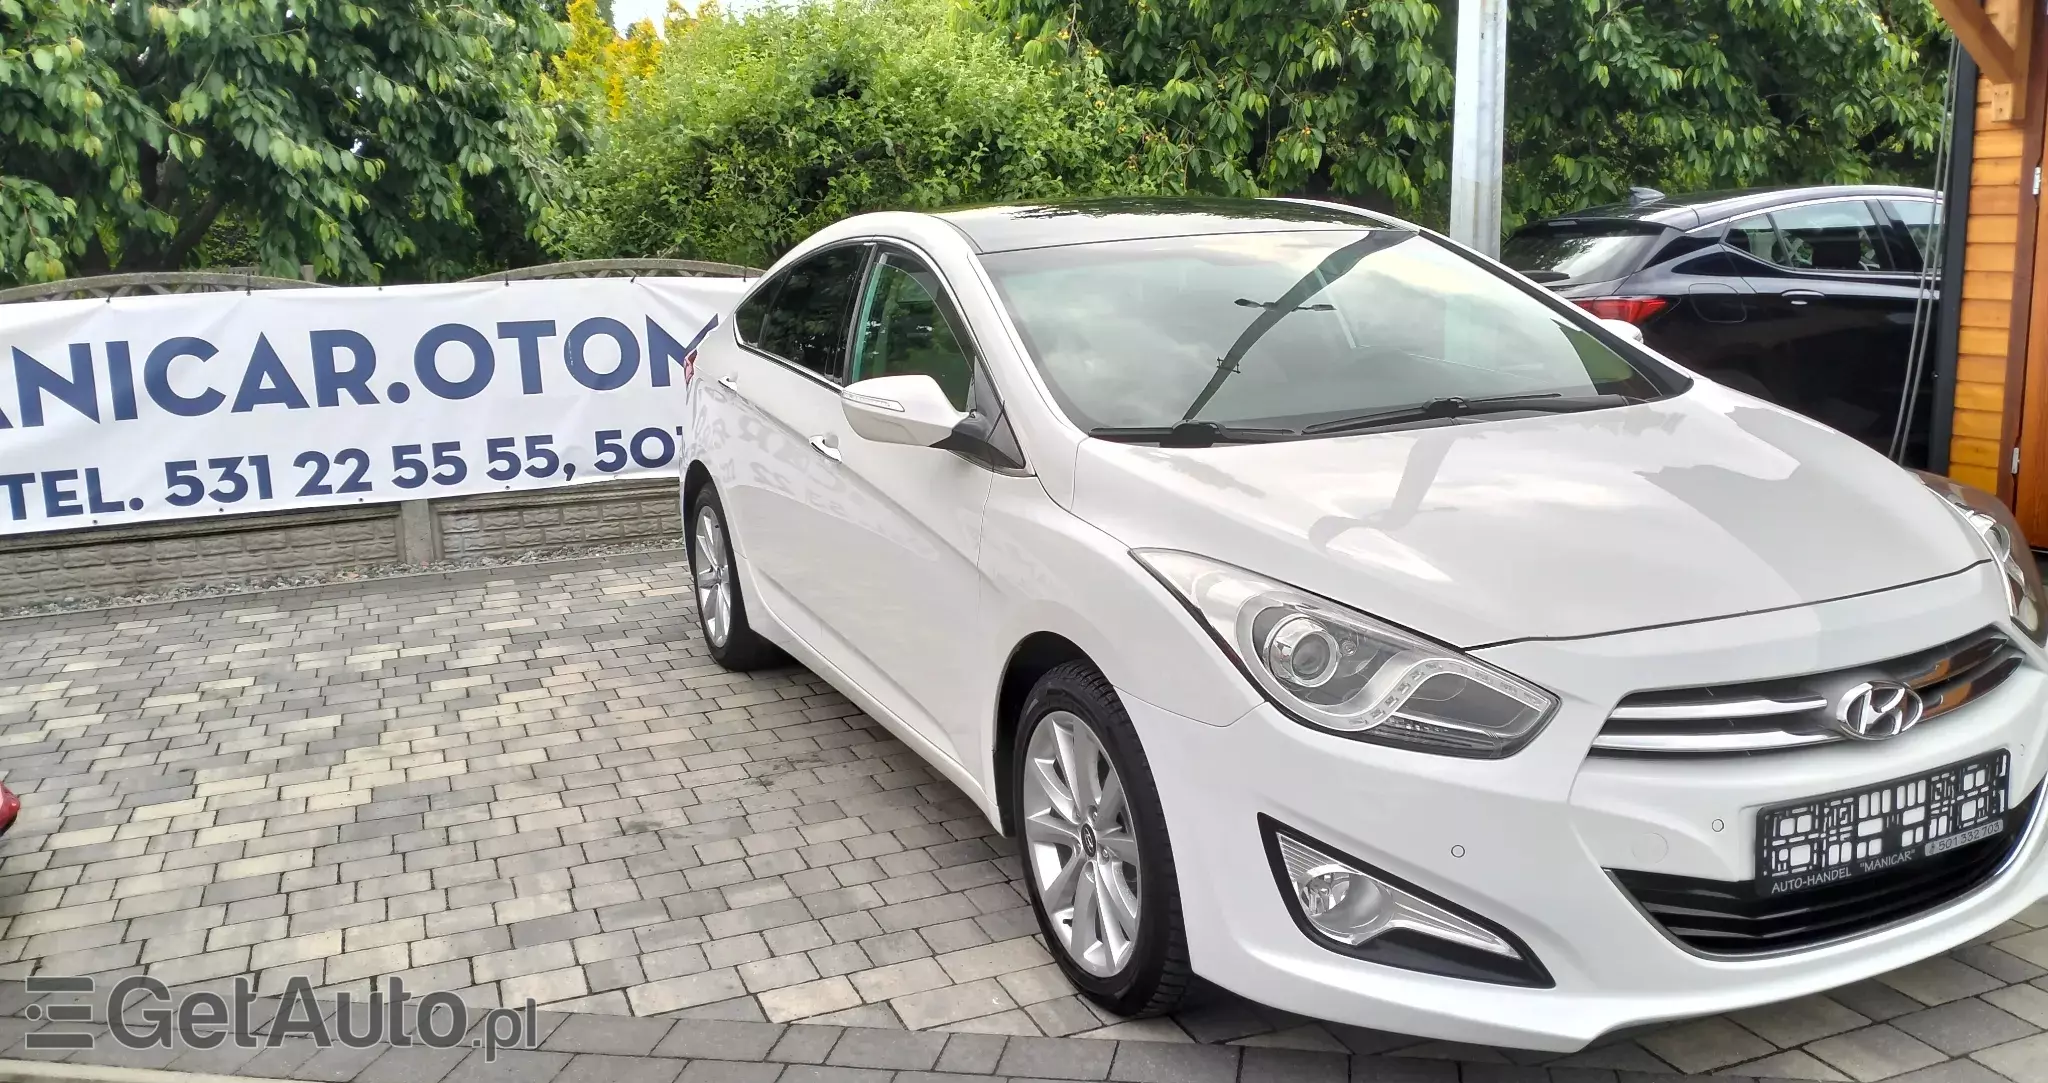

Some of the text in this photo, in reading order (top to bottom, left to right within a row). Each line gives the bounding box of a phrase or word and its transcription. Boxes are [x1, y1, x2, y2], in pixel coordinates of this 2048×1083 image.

[0, 313, 718, 429] NICAR.OTOM
[0, 426, 683, 521] TEL. 531 22 55 55, 50
[1771, 822, 2000, 894] AUTO-HANDEL "MANICAR" 501 332 703
